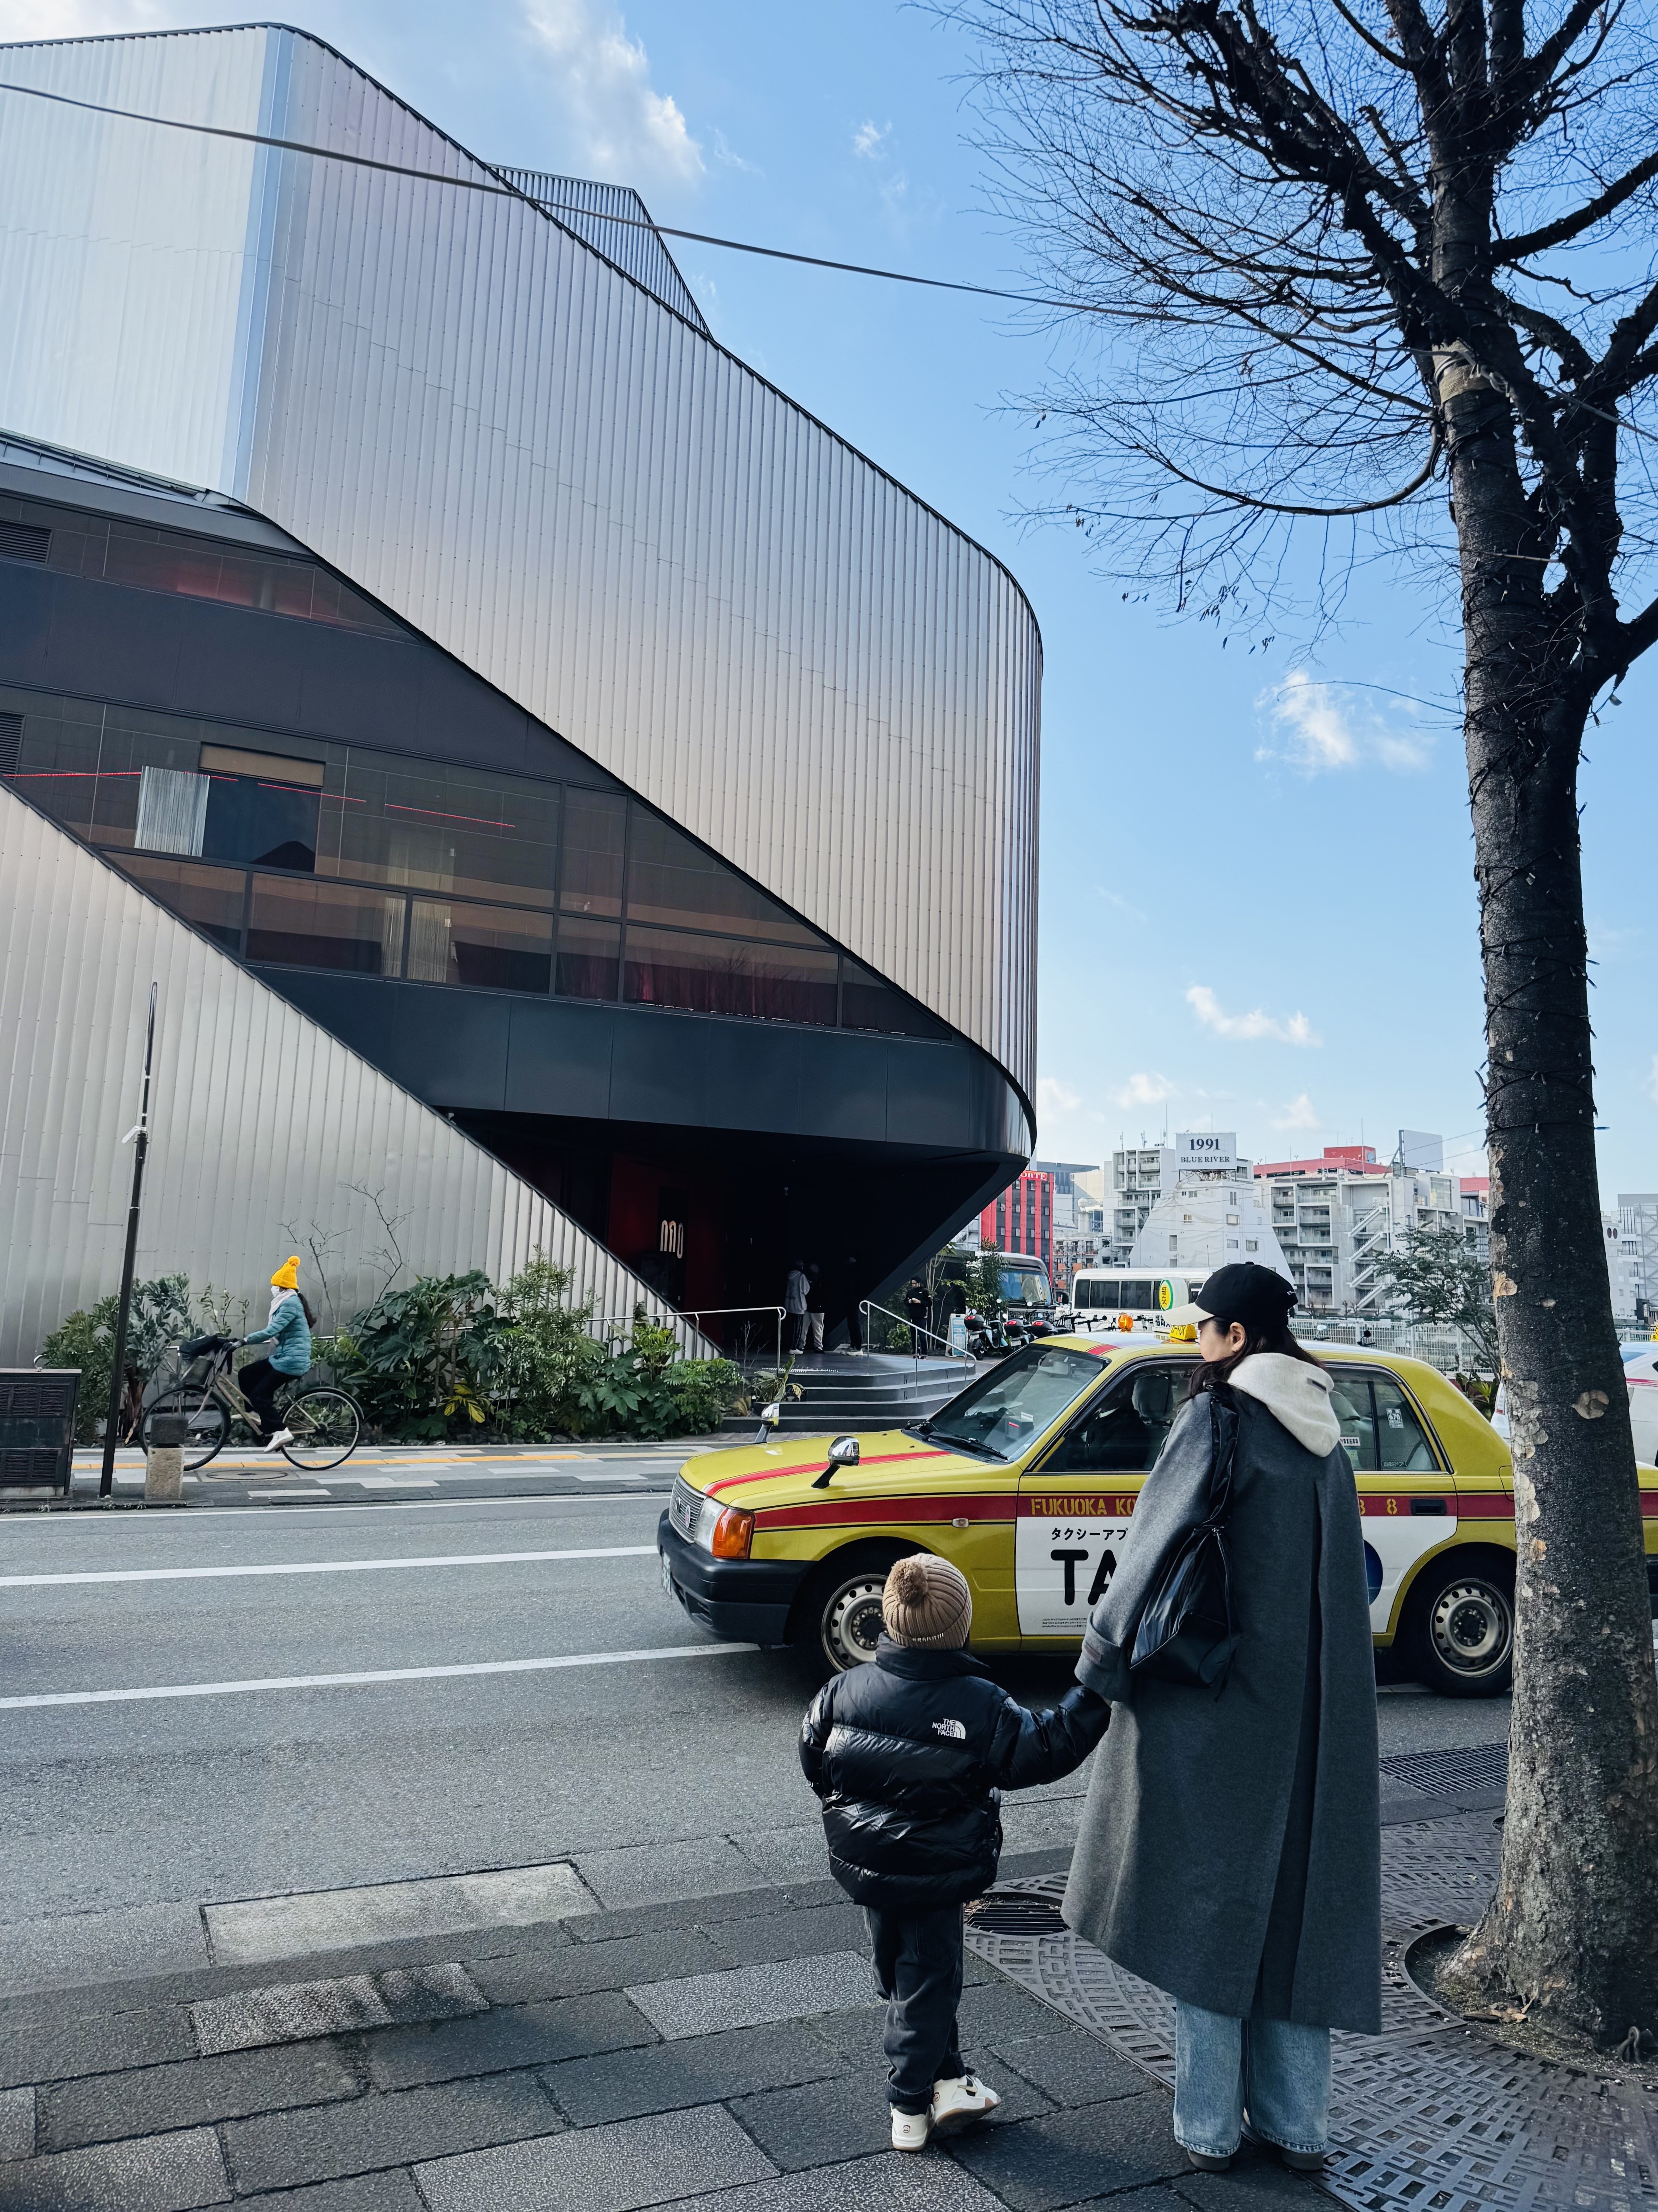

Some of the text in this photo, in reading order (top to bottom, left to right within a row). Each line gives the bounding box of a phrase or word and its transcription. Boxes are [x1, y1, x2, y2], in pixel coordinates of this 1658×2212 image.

[1189, 1138, 1220, 1150] 1991
[1031, 1498, 1107, 1515] FUKUOKA
[1051, 1527, 1129, 1540] タクシーアプ
[1051, 1549, 1117, 1606] TA
[932, 1722, 955, 1732] NORTH
